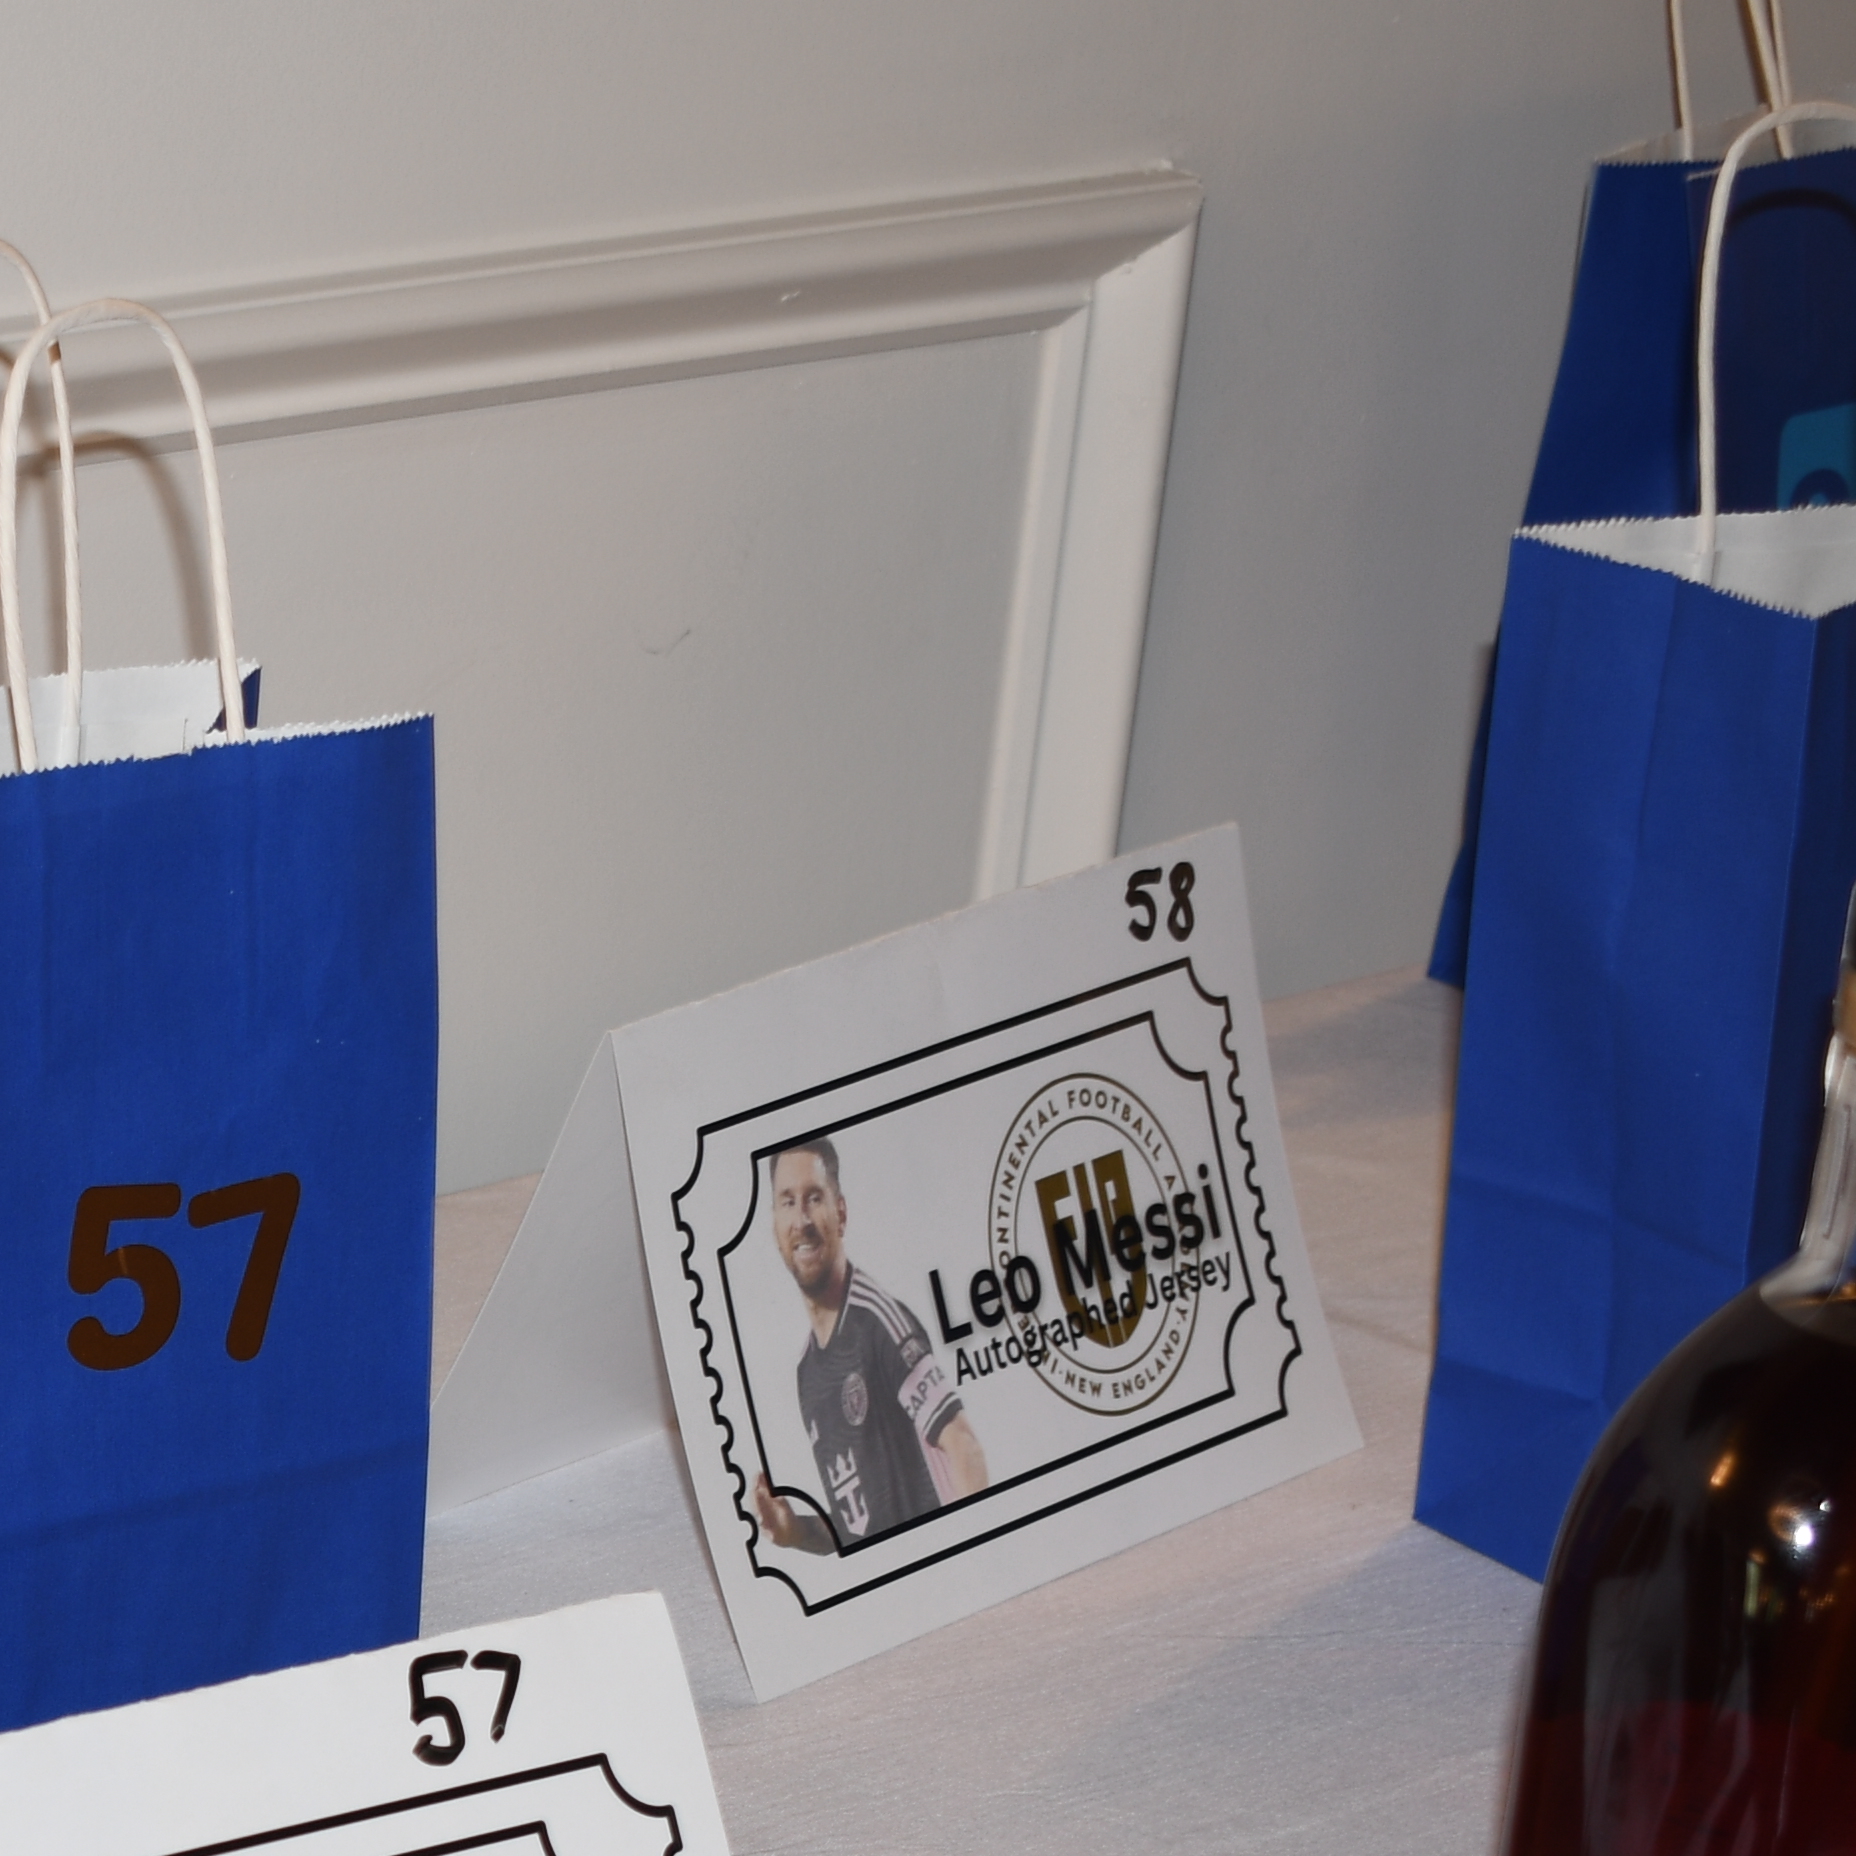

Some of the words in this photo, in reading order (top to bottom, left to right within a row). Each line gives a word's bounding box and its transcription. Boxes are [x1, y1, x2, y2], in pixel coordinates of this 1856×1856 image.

[1125, 861, 1195, 942] 58
[1067, 1088, 1162, 1162] FOOTBALL
[66, 1171, 301, 1372] 57
[929, 1255, 1042, 1345] Leo
[1053, 1163, 1222, 1296] Messi
[956, 1279, 1138, 1387] Autographed
[1146, 1251, 1231, 1310] Jersey
[1064, 1371, 1103, 1398] NEW
[1111, 1329, 1181, 1400] ENGLAND
[408, 1649, 522, 1767] 57
